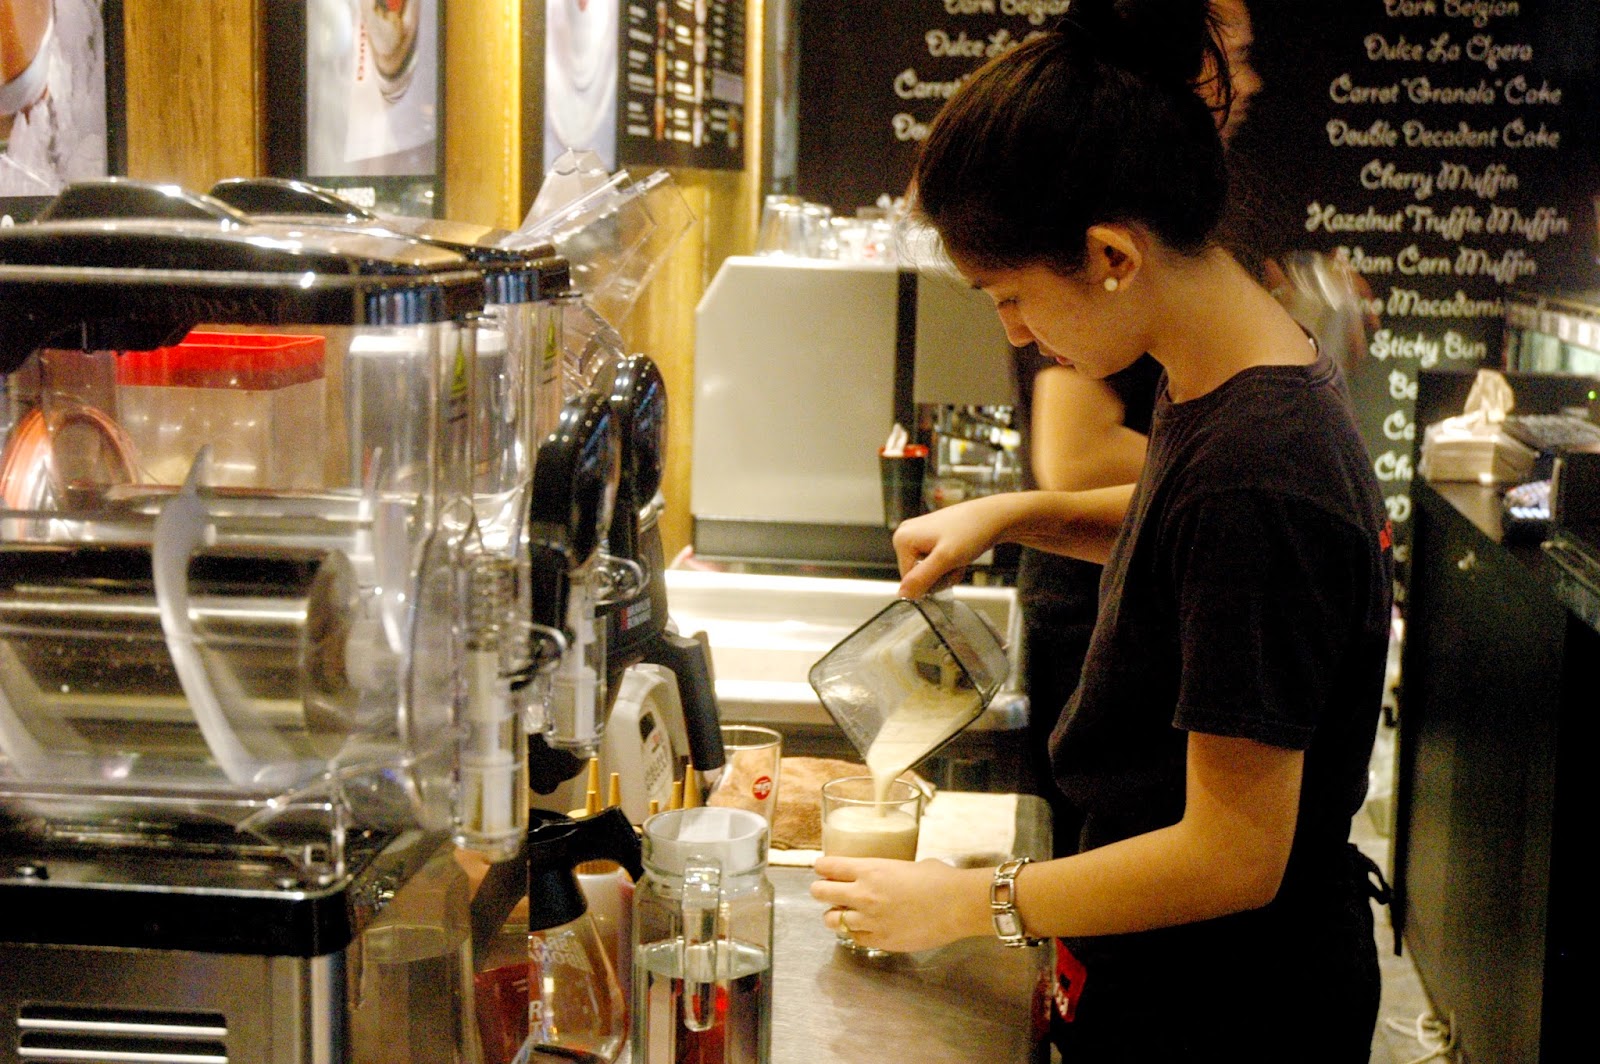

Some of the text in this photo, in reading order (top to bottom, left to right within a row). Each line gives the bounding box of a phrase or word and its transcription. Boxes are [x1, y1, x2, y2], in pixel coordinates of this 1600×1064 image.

[1466, 34, 1533, 71] Opera
[1329, 73, 1400, 104] Carrot
[1504, 75, 1562, 105] Cake
[1326, 117, 1560, 149] Double Decadent Cake
[1360, 159, 1518, 200] Cherry Muffin
[1304, 201, 1569, 242] Hazelnut Truffle Muffin
[1397, 244, 1450, 276] Corn
[1454, 246, 1538, 284] Muffin
[1369, 329, 1487, 368] Sticky Bun
